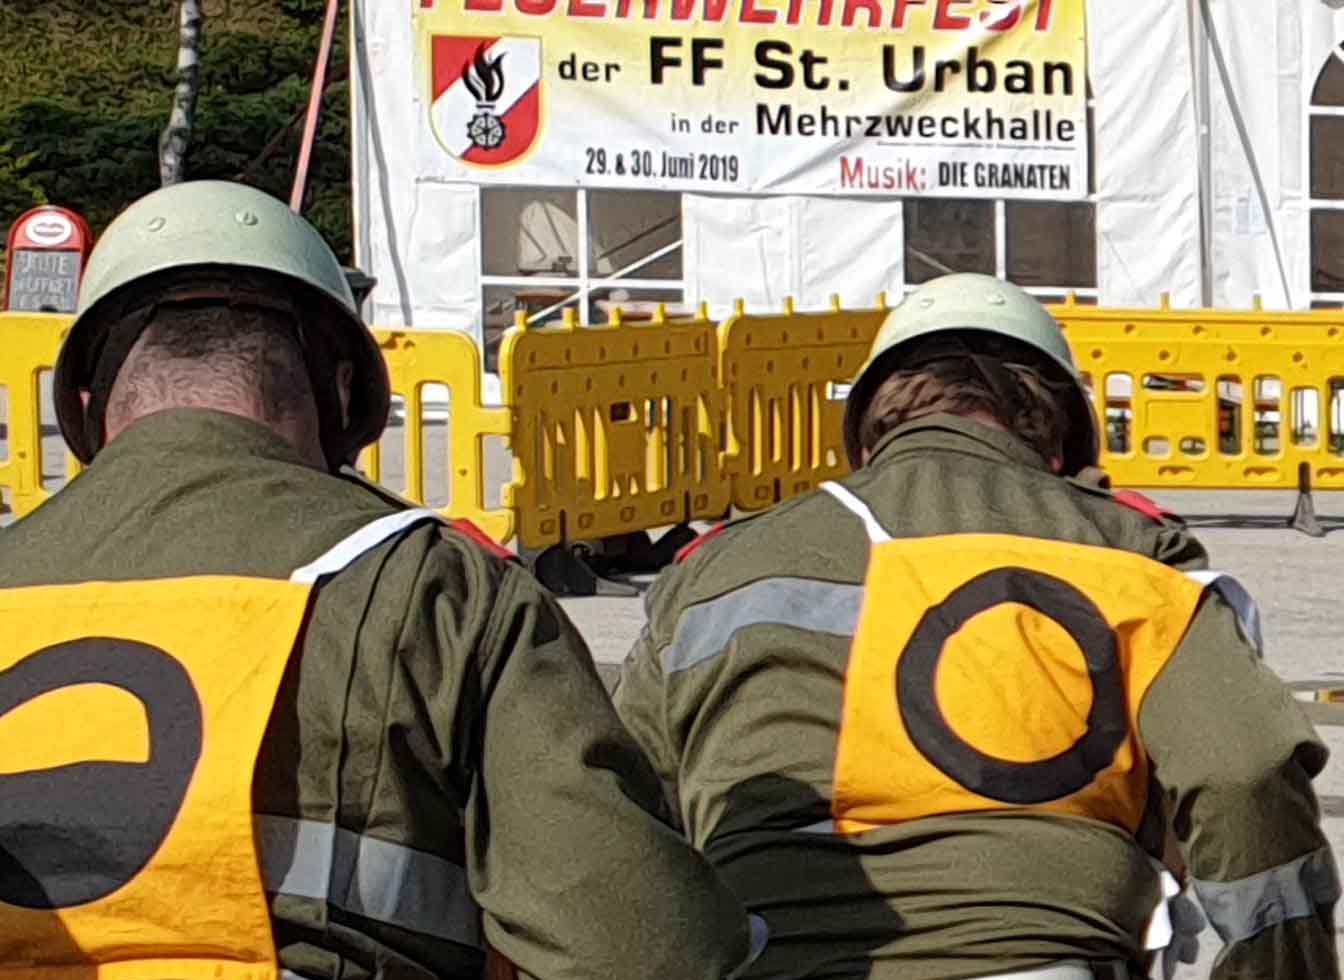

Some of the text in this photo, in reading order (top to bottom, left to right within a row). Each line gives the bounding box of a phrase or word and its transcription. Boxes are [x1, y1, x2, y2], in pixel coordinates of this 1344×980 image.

[558, 36, 1074, 96] der FF St. Urban
[671, 103, 1075, 142] in der Mehrzweckhalle
[586, 147, 739, 183] 29. & 30. Juni 2019
[840, 155, 1071, 190] Musik: DIE GRANATEN
